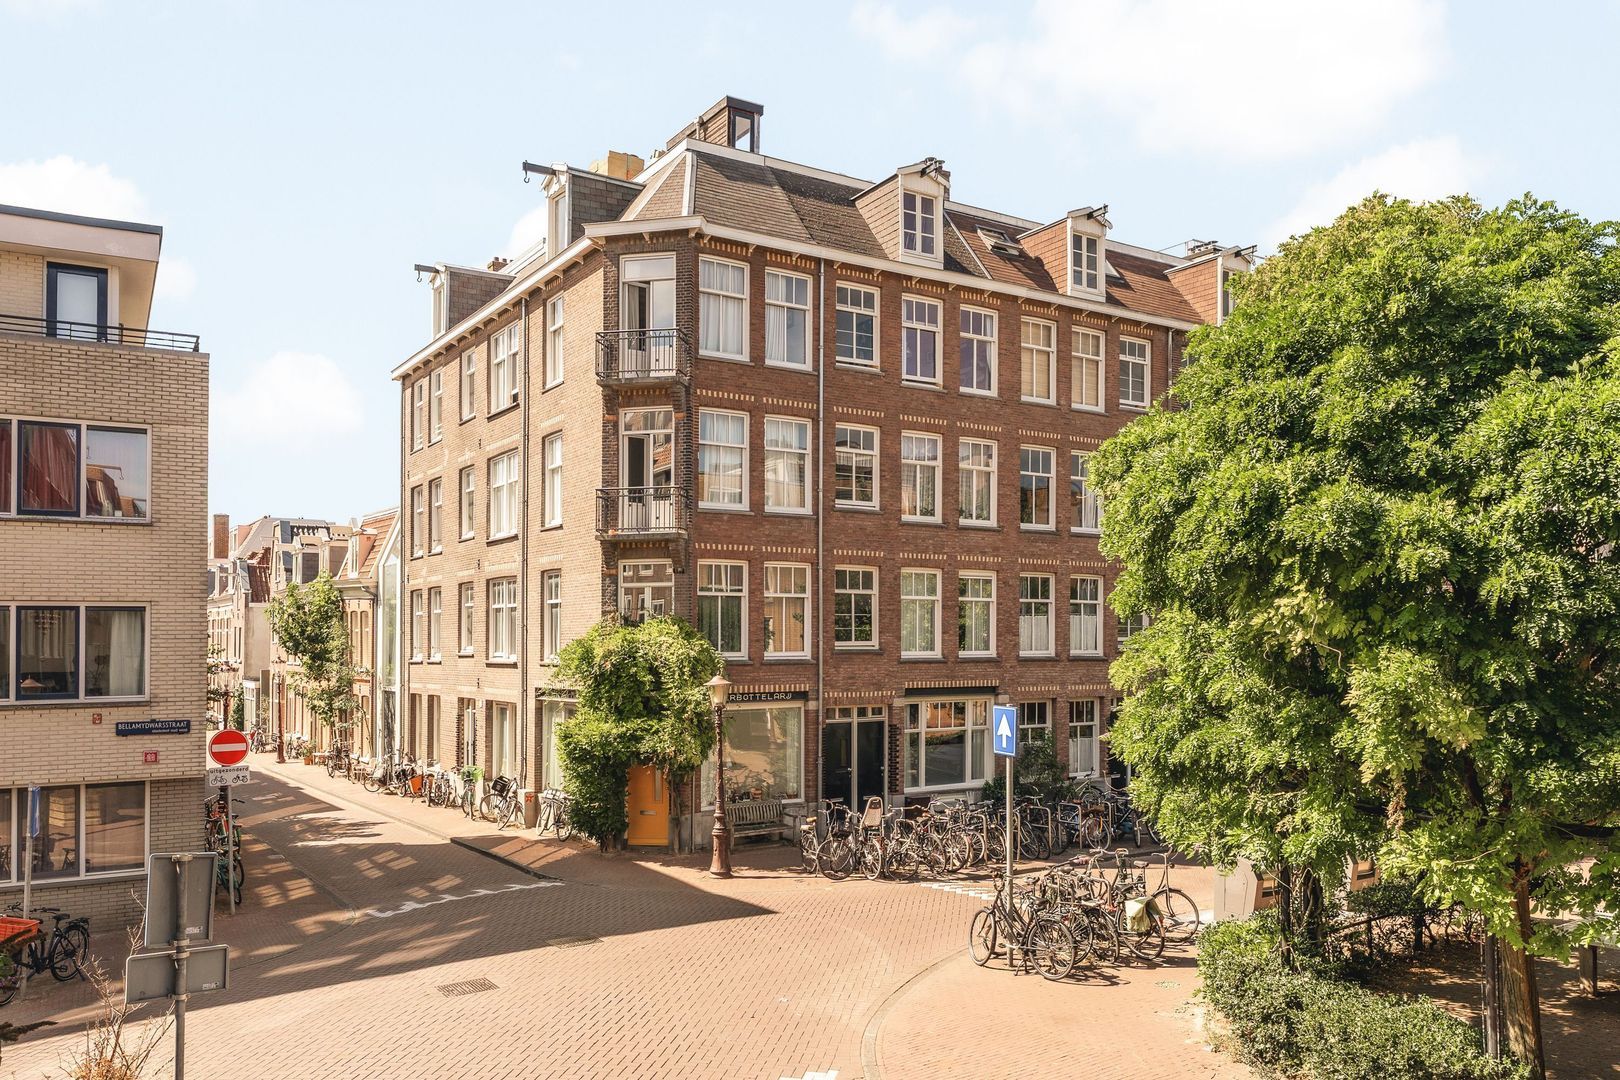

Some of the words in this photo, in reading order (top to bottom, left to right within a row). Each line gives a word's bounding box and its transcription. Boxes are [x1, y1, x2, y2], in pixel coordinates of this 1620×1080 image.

[729, 692, 792, 701] RBOTTELARIJ
[118, 721, 187, 730] BELLAMYDWARSSTRAAT
[209, 766, 249, 774] uitgezonderd
